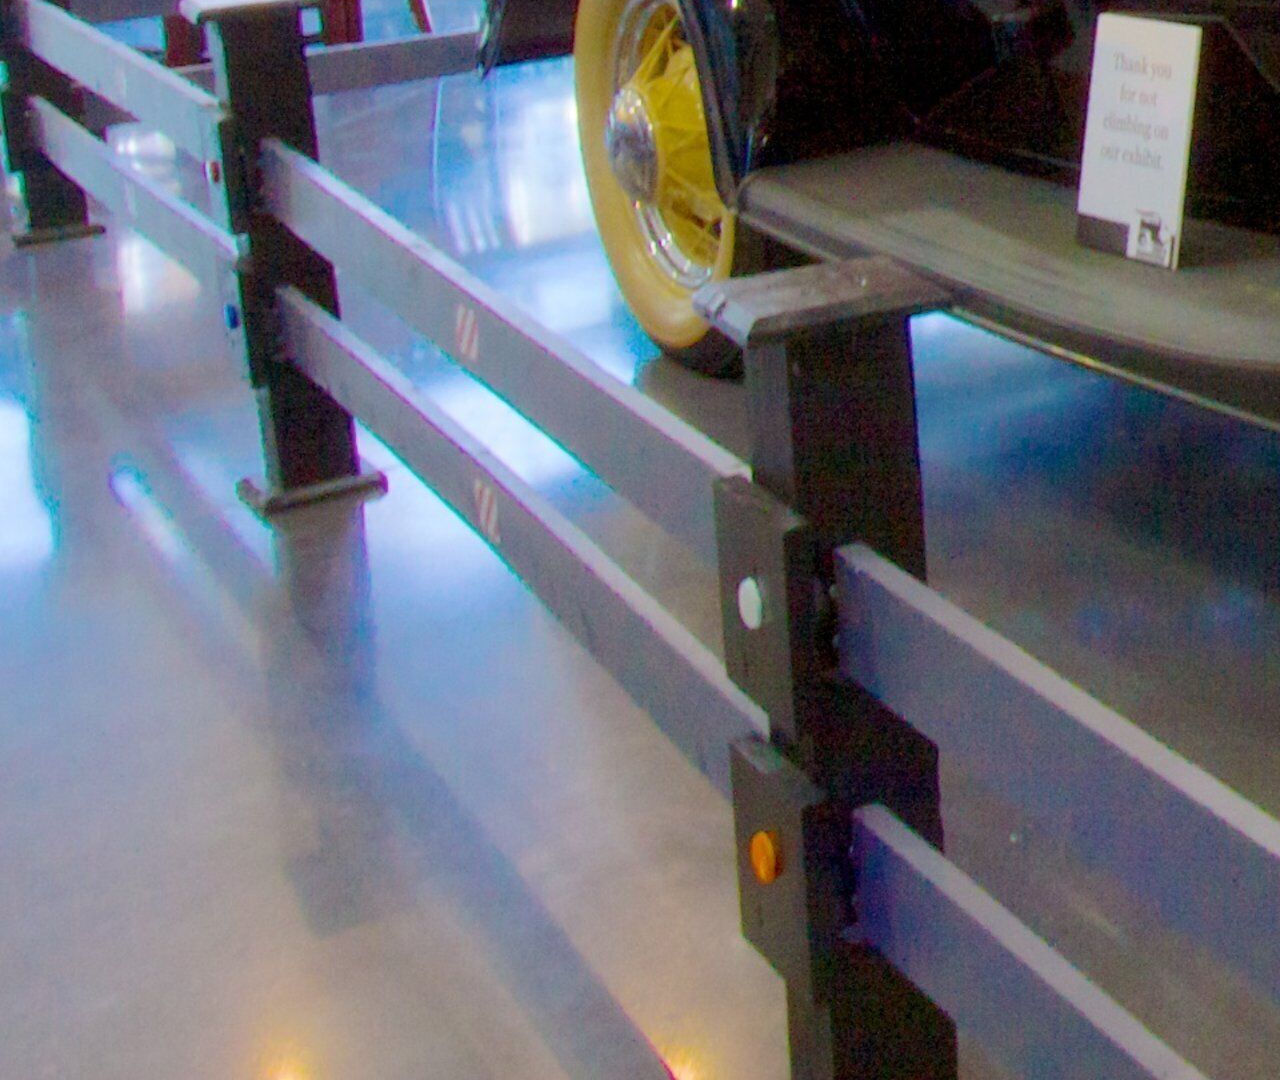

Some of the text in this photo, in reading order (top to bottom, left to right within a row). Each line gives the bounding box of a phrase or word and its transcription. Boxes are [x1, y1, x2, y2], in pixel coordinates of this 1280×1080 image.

[1113, 51, 1172, 81] Thank you
[1120, 82, 1157, 107] for not
[1103, 111, 1170, 141] climbing on
